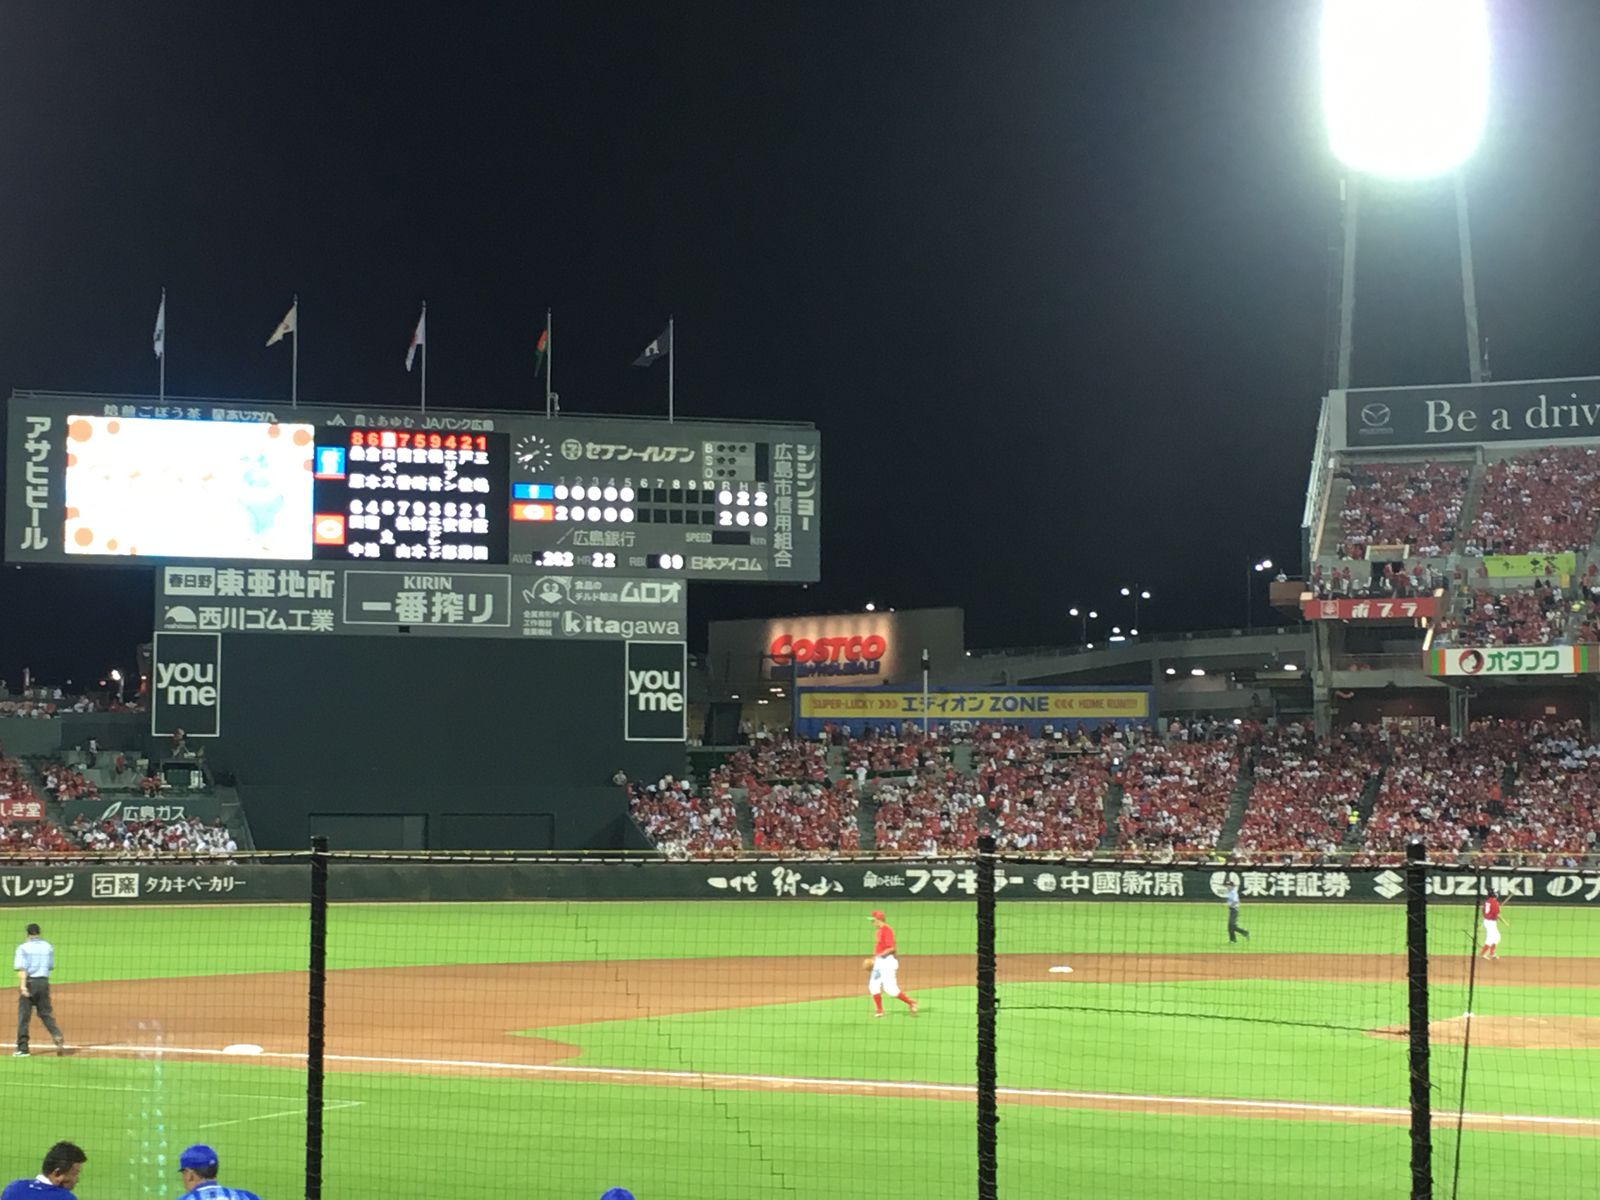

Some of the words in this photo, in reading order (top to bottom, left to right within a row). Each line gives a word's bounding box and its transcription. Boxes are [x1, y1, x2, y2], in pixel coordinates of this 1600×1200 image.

[1424, 399, 1478, 434] Be
[1490, 407, 1512, 431] a
[351, 431, 364, 446] 8
[367, 432, 380, 446] 6
[398, 433, 410, 447] 7
[414, 434, 427, 448] 5
[429, 434, 441, 448] 9
[445, 435, 457, 449] 4
[460, 435, 473, 450] 2
[475, 436, 487, 450] 1
[705, 443, 713, 453] B
[705, 456, 713, 466] S
[20, 416, 52, 550] アサヒビール
[560, 476, 566, 486] 1
[575, 476, 583, 486] 2
[592, 477, 599, 486] 3
[607, 478, 615, 487] 4
[624, 478, 632, 487] 5
[640, 478, 648, 488] 6
[657, 479, 664, 488] 7
[672, 479, 680, 489] 8
[688, 480, 697, 490] 9
[703, 480, 715, 490] 10
[736, 491, 750, 506] 2
[754, 491, 768, 506] 2
[774, 442, 793, 568] 広島市信用組合
[397, 501, 410, 516] 7
[428, 501, 441, 517] 3
[459, 502, 472, 518] 2
[475, 503, 486, 518] 1
[555, 506, 569, 520] 2
[719, 511, 733, 526] 2
[573, 530, 636, 547] 広島銀行
[685, 532, 712, 543] SPEED
[512, 554, 532, 564] AVG
[577, 555, 592, 565] HR
[592, 552, 616, 567] 22
[691, 556, 763, 571] 日本アイコム
[169, 573, 213, 588] 春日野
[217, 568, 335, 598] 東亜地所
[404, 576, 452, 590] KIRIN
[620, 581, 682, 604] ムロオ
[362, 592, 493, 623] 一番搾り
[1352, 600, 1418, 618] ポプラ
[198, 606, 335, 632] 西川ゴム工業
[564, 611, 680, 638] kitagawa
[770, 634, 886, 665] COSTCO
[1486, 650, 1560, 672] オタフク
[157, 662, 213, 689] you
[629, 670, 681, 695] you
[167, 685, 216, 707] me
[638, 692, 684, 712] me
[902, 696, 984, 713] エディオン
[990, 696, 1049, 712] ZONE
[0, 802, 41, 818] しき堂
[123, 805, 186, 822] 広島ガス
[94, 875, 138, 896] 石窯
[145, 876, 246, 893] タカキベーカリー
[905, 869, 1024, 894] フマキラー
[1241, 871, 1351, 897] 東洋証券
